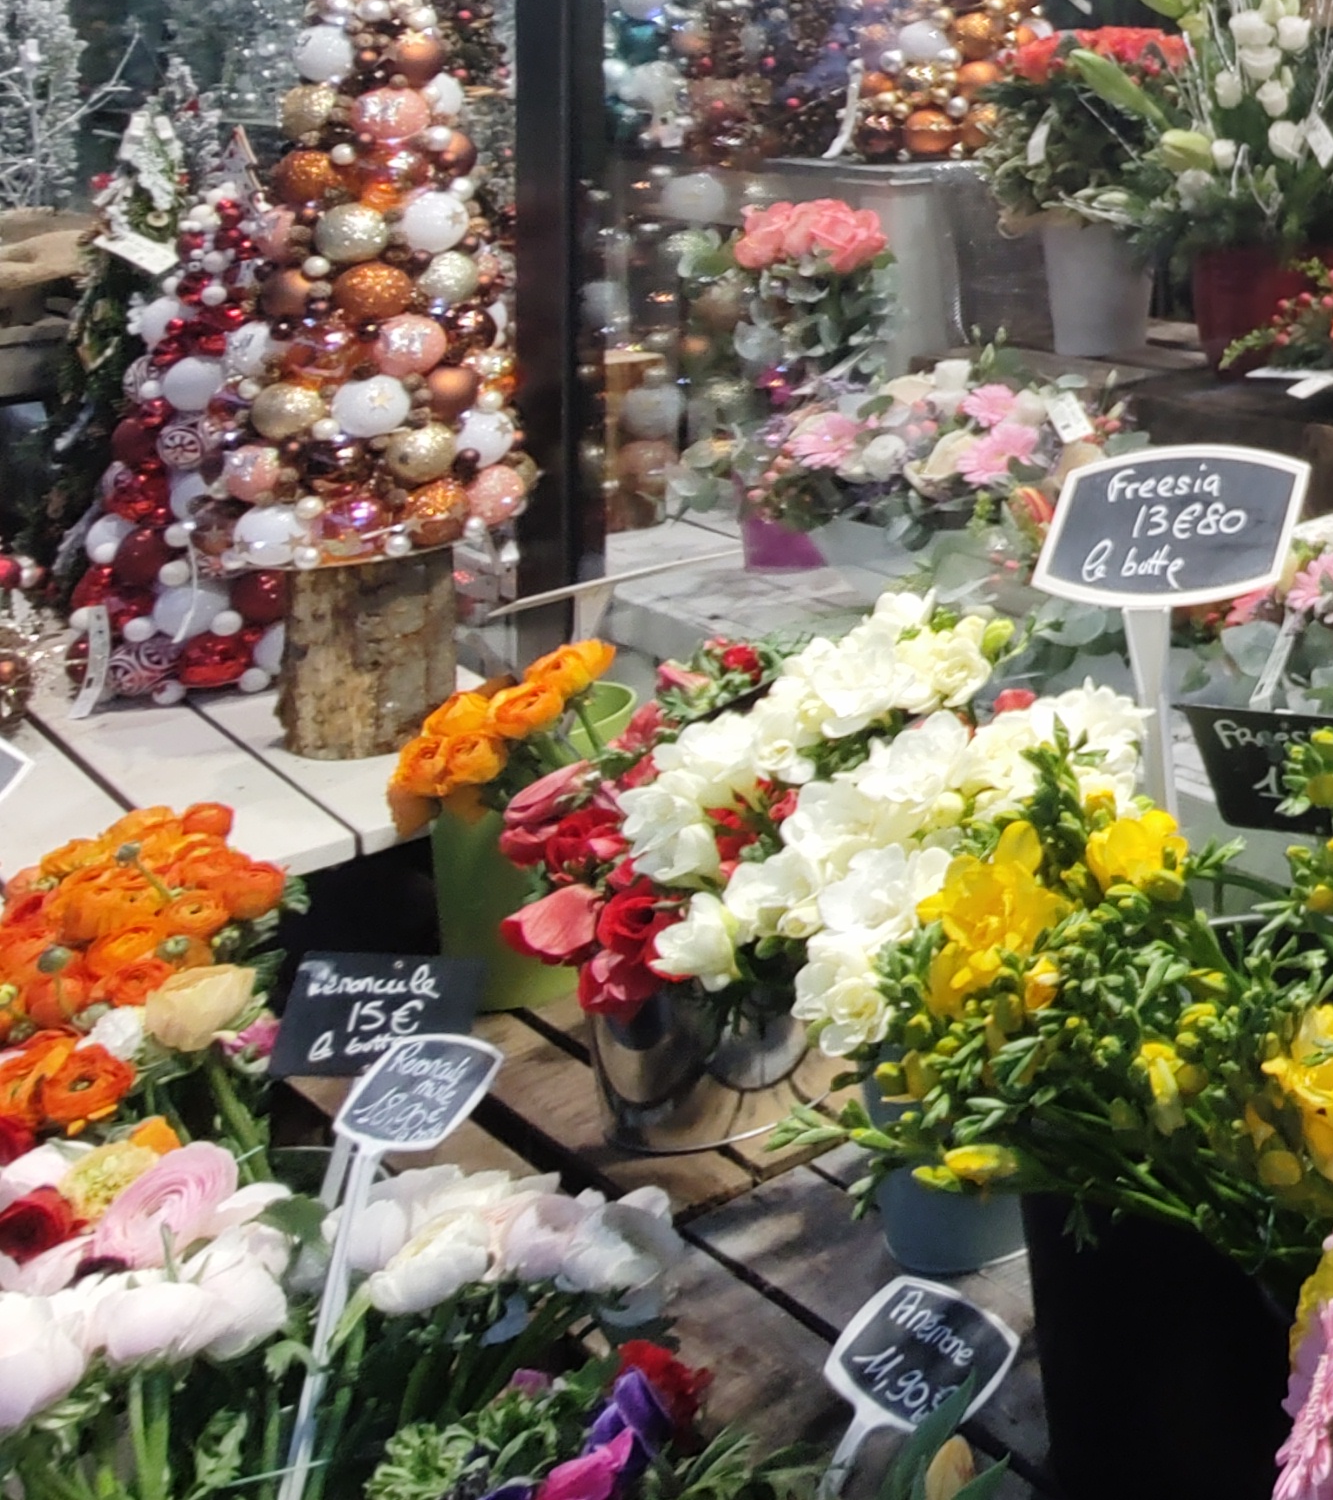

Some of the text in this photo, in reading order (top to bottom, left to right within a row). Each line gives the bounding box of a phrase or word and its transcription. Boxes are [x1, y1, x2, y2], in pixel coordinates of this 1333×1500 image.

[1107, 463, 1221, 503] Freesia
[1132, 503, 1247, 539] 13€80
[1121, 545, 1186, 590] botte
[346, 1000, 425, 1034] 15€
